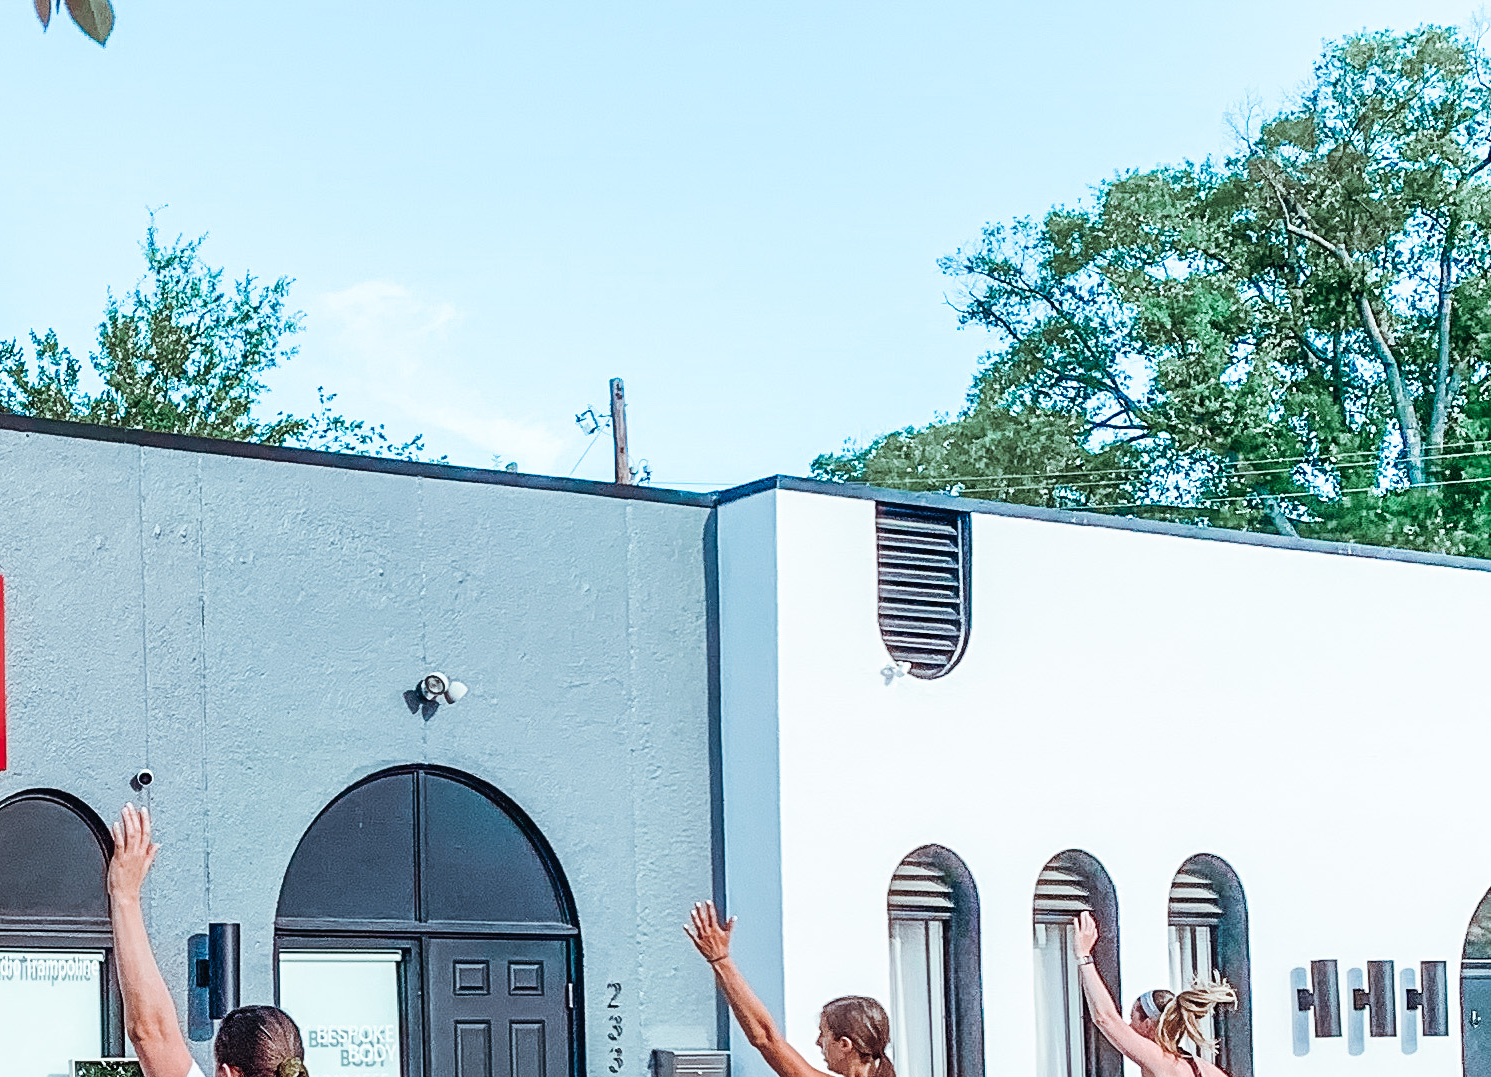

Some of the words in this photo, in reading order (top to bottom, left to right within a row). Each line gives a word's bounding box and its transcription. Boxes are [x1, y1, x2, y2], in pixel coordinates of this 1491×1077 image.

[23, 954, 99, 981] Trampoline
[316, 1025, 395, 1044] BESPOKE
[348, 1043, 397, 1062] BODY
